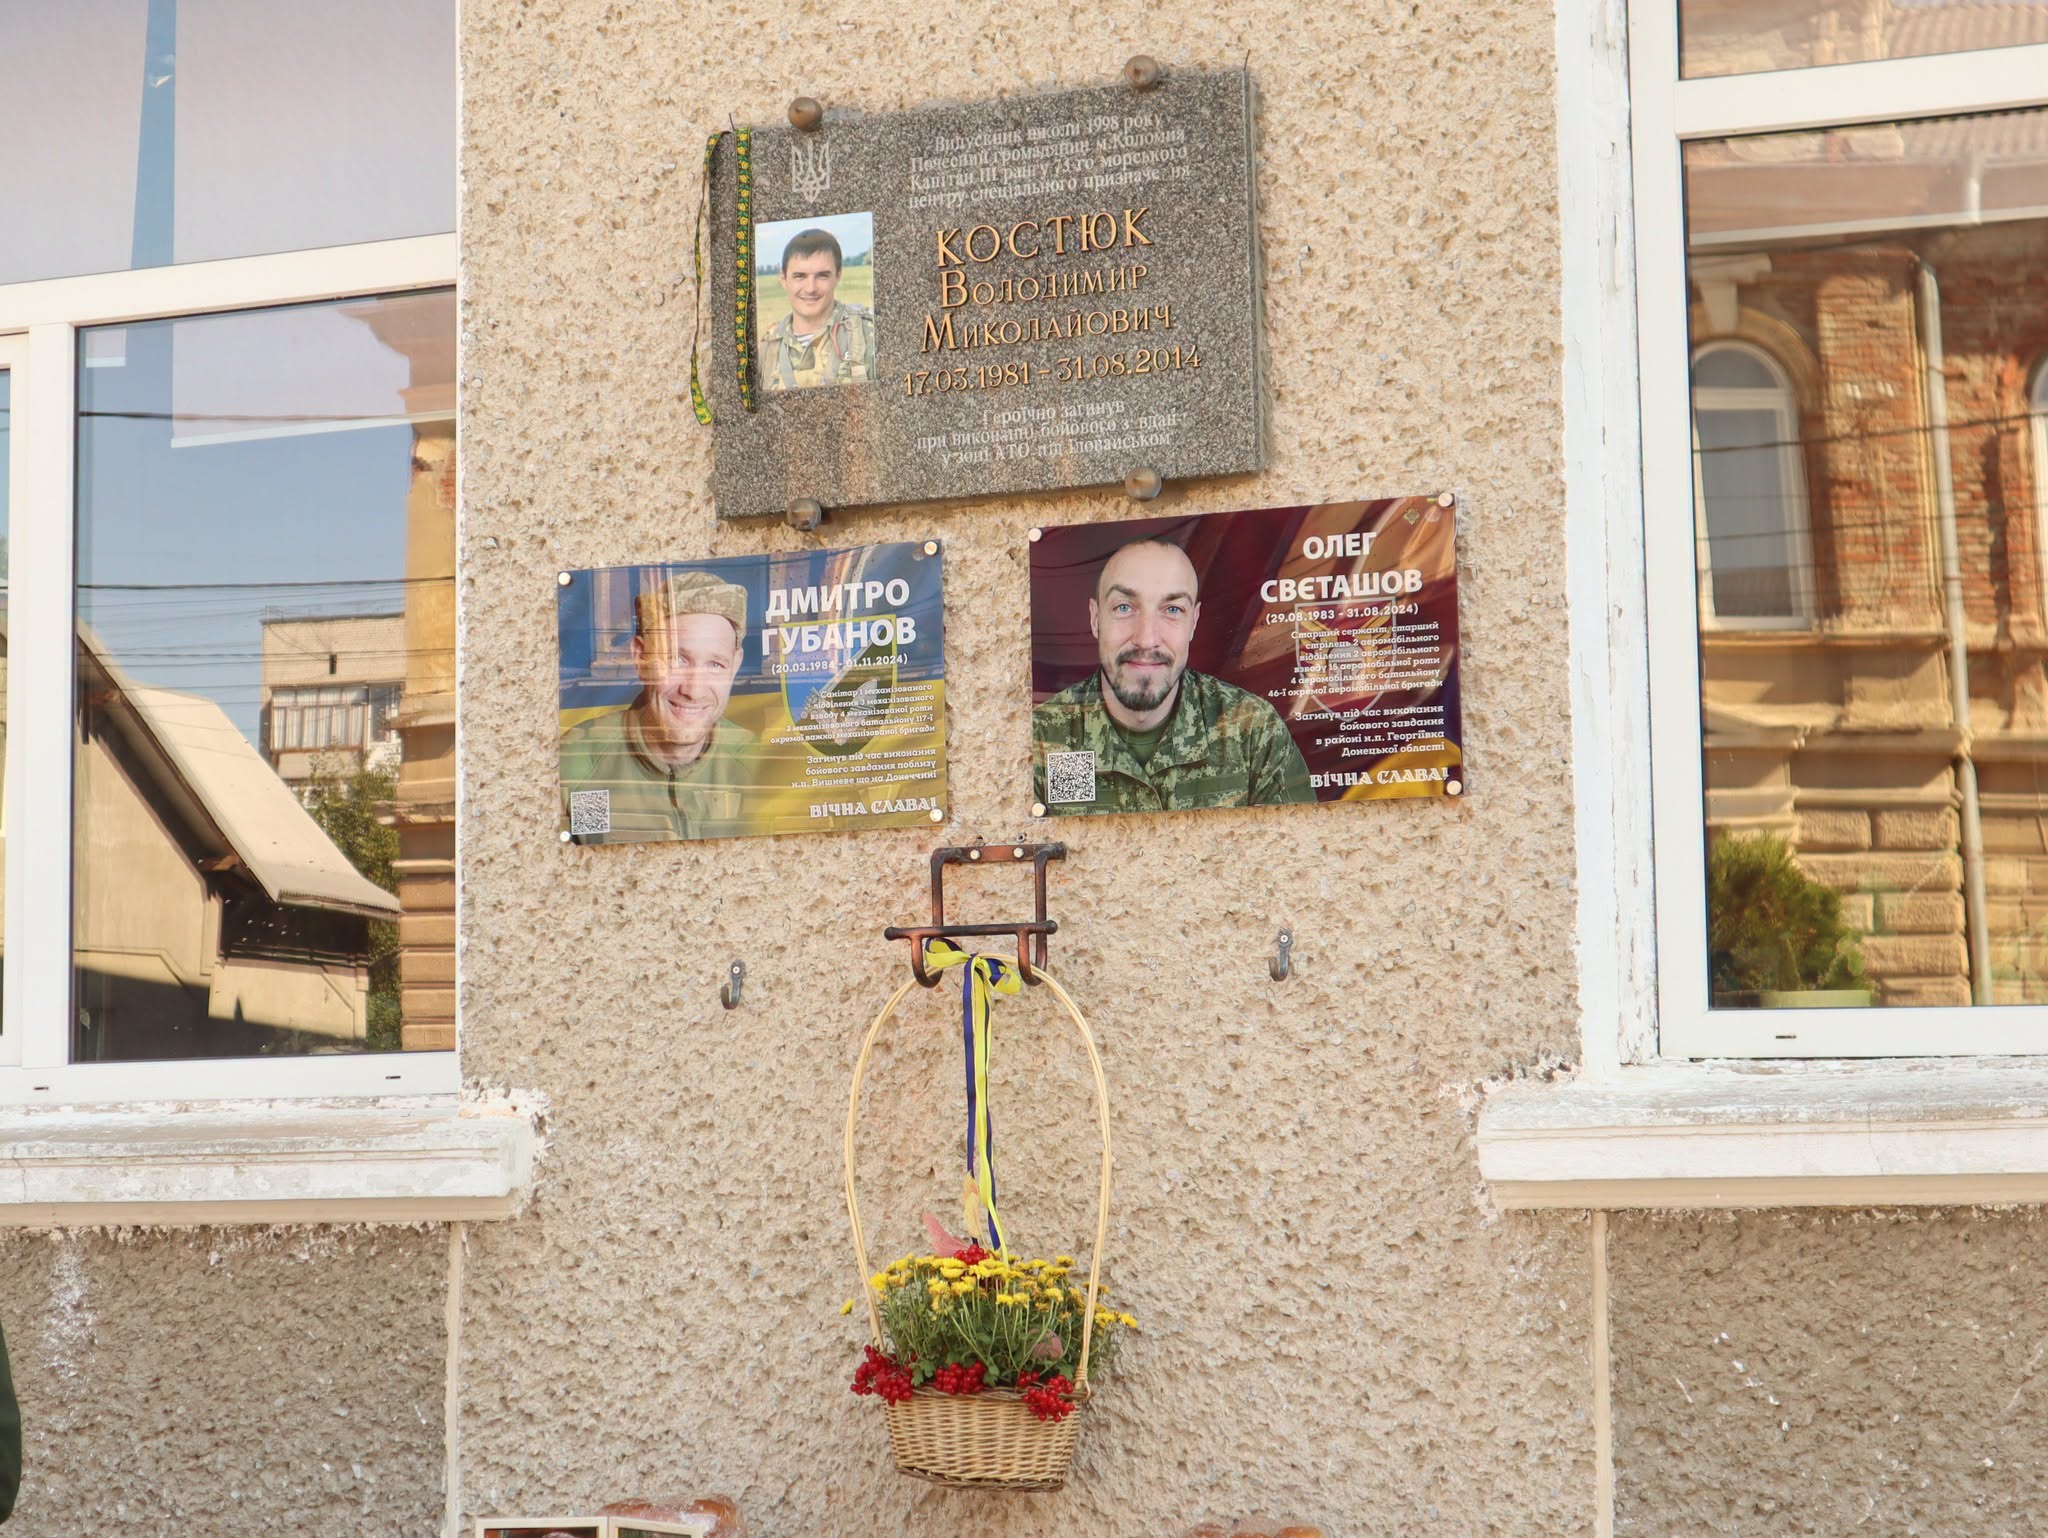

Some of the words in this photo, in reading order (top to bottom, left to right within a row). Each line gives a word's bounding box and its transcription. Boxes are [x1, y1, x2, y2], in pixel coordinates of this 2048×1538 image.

[935, 131, 1022, 152] Випускник
[1088, 115, 1119, 133] 1998
[910, 172, 974, 191] Капітан
[1101, 146, 1187, 170] морського
[911, 149, 988, 172] Почесний
[909, 191, 965, 208] центру
[970, 178, 1077, 201] спеціального
[1084, 164, 1190, 190] призначеня
[936, 207, 1152, 267] КОСТЮК
[940, 265, 1148, 308] Володимир
[921, 305, 1172, 353] Миколайович
[904, 362, 1031, 397] 17.03.1981
[1057, 345, 1201, 381] 31.08.2014
[983, 406, 1056, 428] Героїчно
[1061, 400, 1125, 419] загинув
[917, 435, 947, 453] при
[1041, 418, 1116, 438] бойового
[995, 443, 1030, 461] АТО
[1303, 532, 1377, 560] ОЛЕГ
[1260, 569, 1423, 603] СВЄТАШОВ
[765, 578, 910, 624] ДМИТРО
[1265, 609, 1335, 625] (29.08.1983
[1347, 603, 1419, 618] 31.08.2024)
[762, 616, 916, 656] ГУБАНОВ
[1291, 627, 1340, 640] Старший
[1342, 625, 1390, 637] сержант,
[1391, 621, 1439, 634] старший
[1305, 639, 1351, 650] стрілець
[1353, 638, 1359, 646] 2
[1360, 633, 1440, 648] аеромобільного
[1353, 649, 1360, 658] 2
[1361, 645, 1440, 659] аеромобільного
[771, 661, 835, 675] (20.03.1984
[1340, 657, 1412, 671] аеромобільної
[1413, 656, 1441, 667] роти
[1290, 676, 1297, 685] 4
[1298, 671, 1377, 685] аеромобільного
[1378, 668, 1441, 680] батальйону
[1268, 687, 1287, 698] 46-ї
[1288, 686, 1327, 698] окремої
[1328, 681, 1400, 695] аеромобільної
[1401, 679, 1443, 692] бригади
[909, 704, 933, 714] роти
[1295, 710, 1341, 721] Загинув
[1343, 708, 1360, 718] під
[1362, 708, 1382, 718] час
[1383, 704, 1444, 716] виконання
[861, 716, 915, 727] батальйону
[1340, 720, 1390, 732] бойового
[1391, 717, 1445, 730] завдання
[771, 734, 804, 745] окремої
[899, 724, 936, 735] бригади
[1324, 733, 1362, 747] районі
[1364, 733, 1385, 743] н.п.
[1387, 729, 1445, 743] Георгіївка
[806, 754, 847, 765] Загинув
[849, 752, 864, 761] під
[865, 752, 882, 761] час
[884, 748, 937, 759] виконання
[1341, 745, 1398, 758] Донецької
[1400, 742, 1445, 753] області
[805, 765, 849, 776] бойового
[850, 762, 896, 773] завдання
[897, 759, 937, 770] поблизу
[812, 776, 855, 787] Вишневе
[856, 776, 870, 785] що
[872, 774, 884, 782] на
[885, 769, 937, 782] Донеччині
[1309, 770, 1373, 788] ВІЧНА
[1376, 766, 1450, 785] СЛАВА!
[809, 801, 867, 818] ВІЧНА
[871, 796, 938, 814] СЛАВА!
